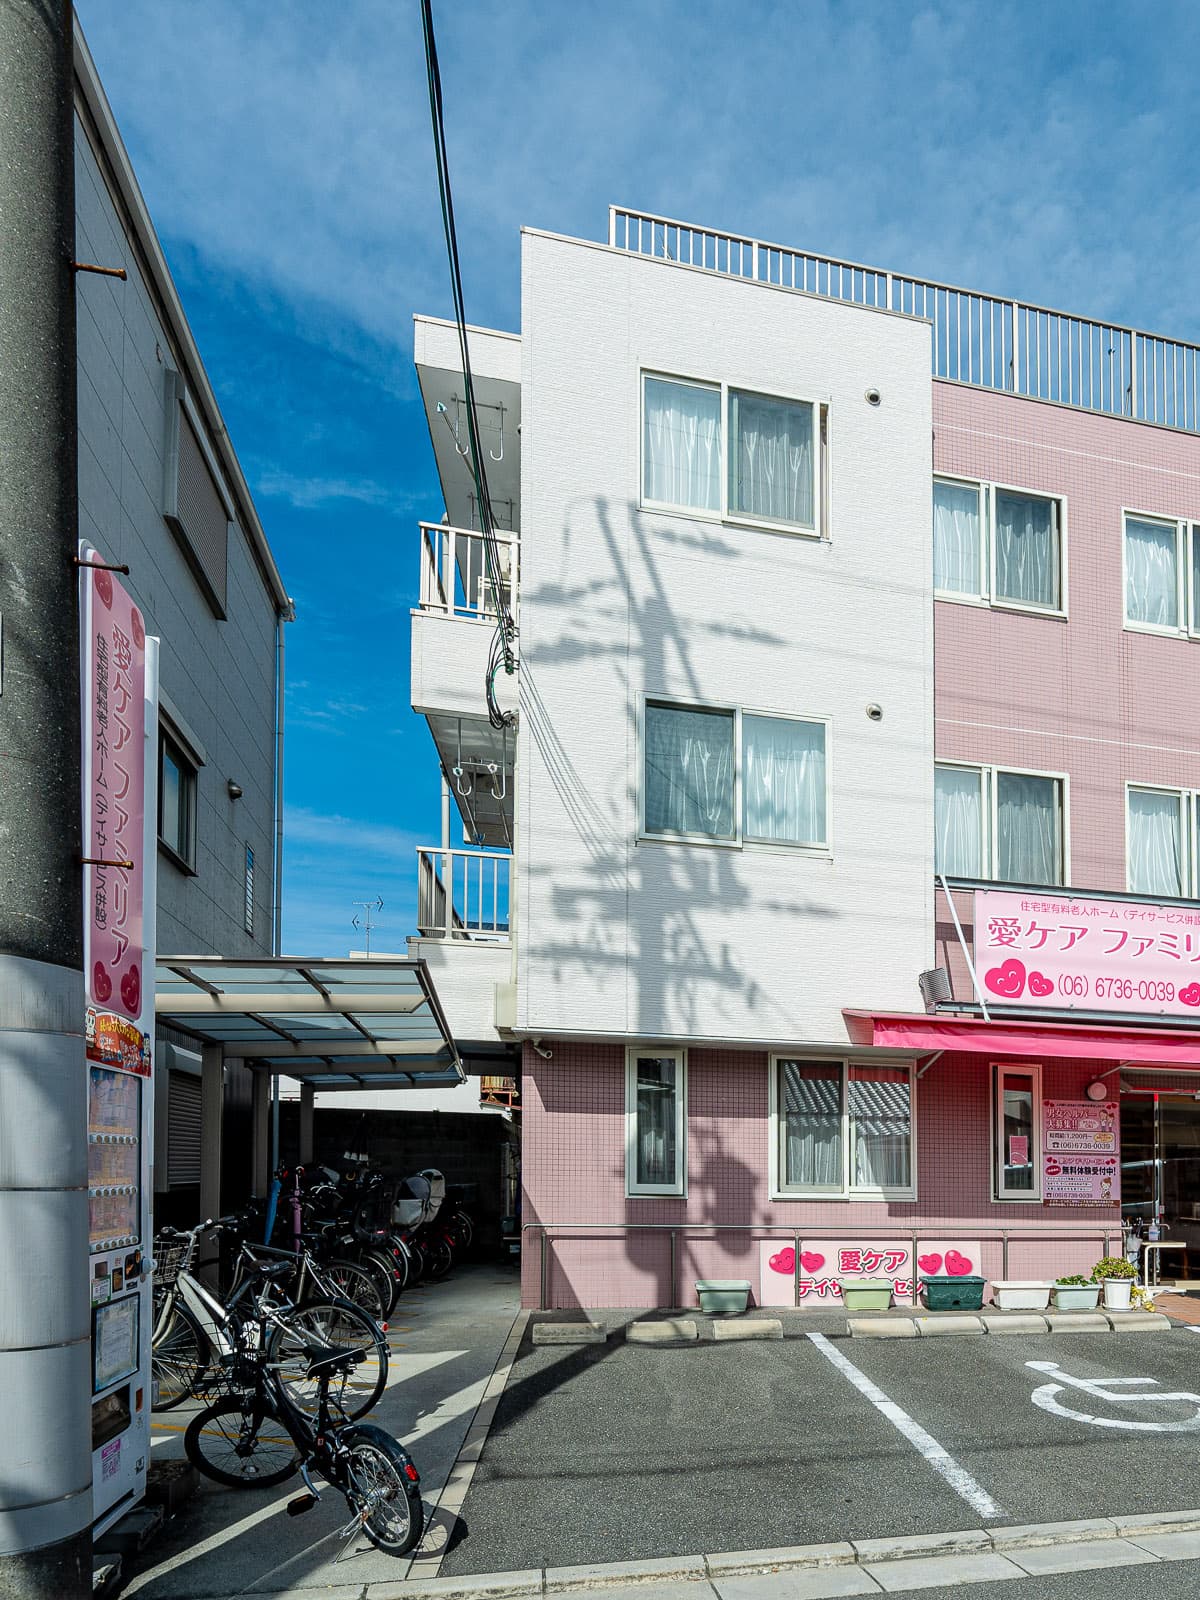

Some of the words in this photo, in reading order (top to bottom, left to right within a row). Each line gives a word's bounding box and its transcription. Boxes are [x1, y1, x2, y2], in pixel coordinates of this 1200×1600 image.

[987, 917, 1088, 951] 愛ケア
[1058, 974, 1088, 998] (06)
[1095, 977, 1175, 1002] 6736-0039
[839, 1249, 907, 1273] 愛ケア
